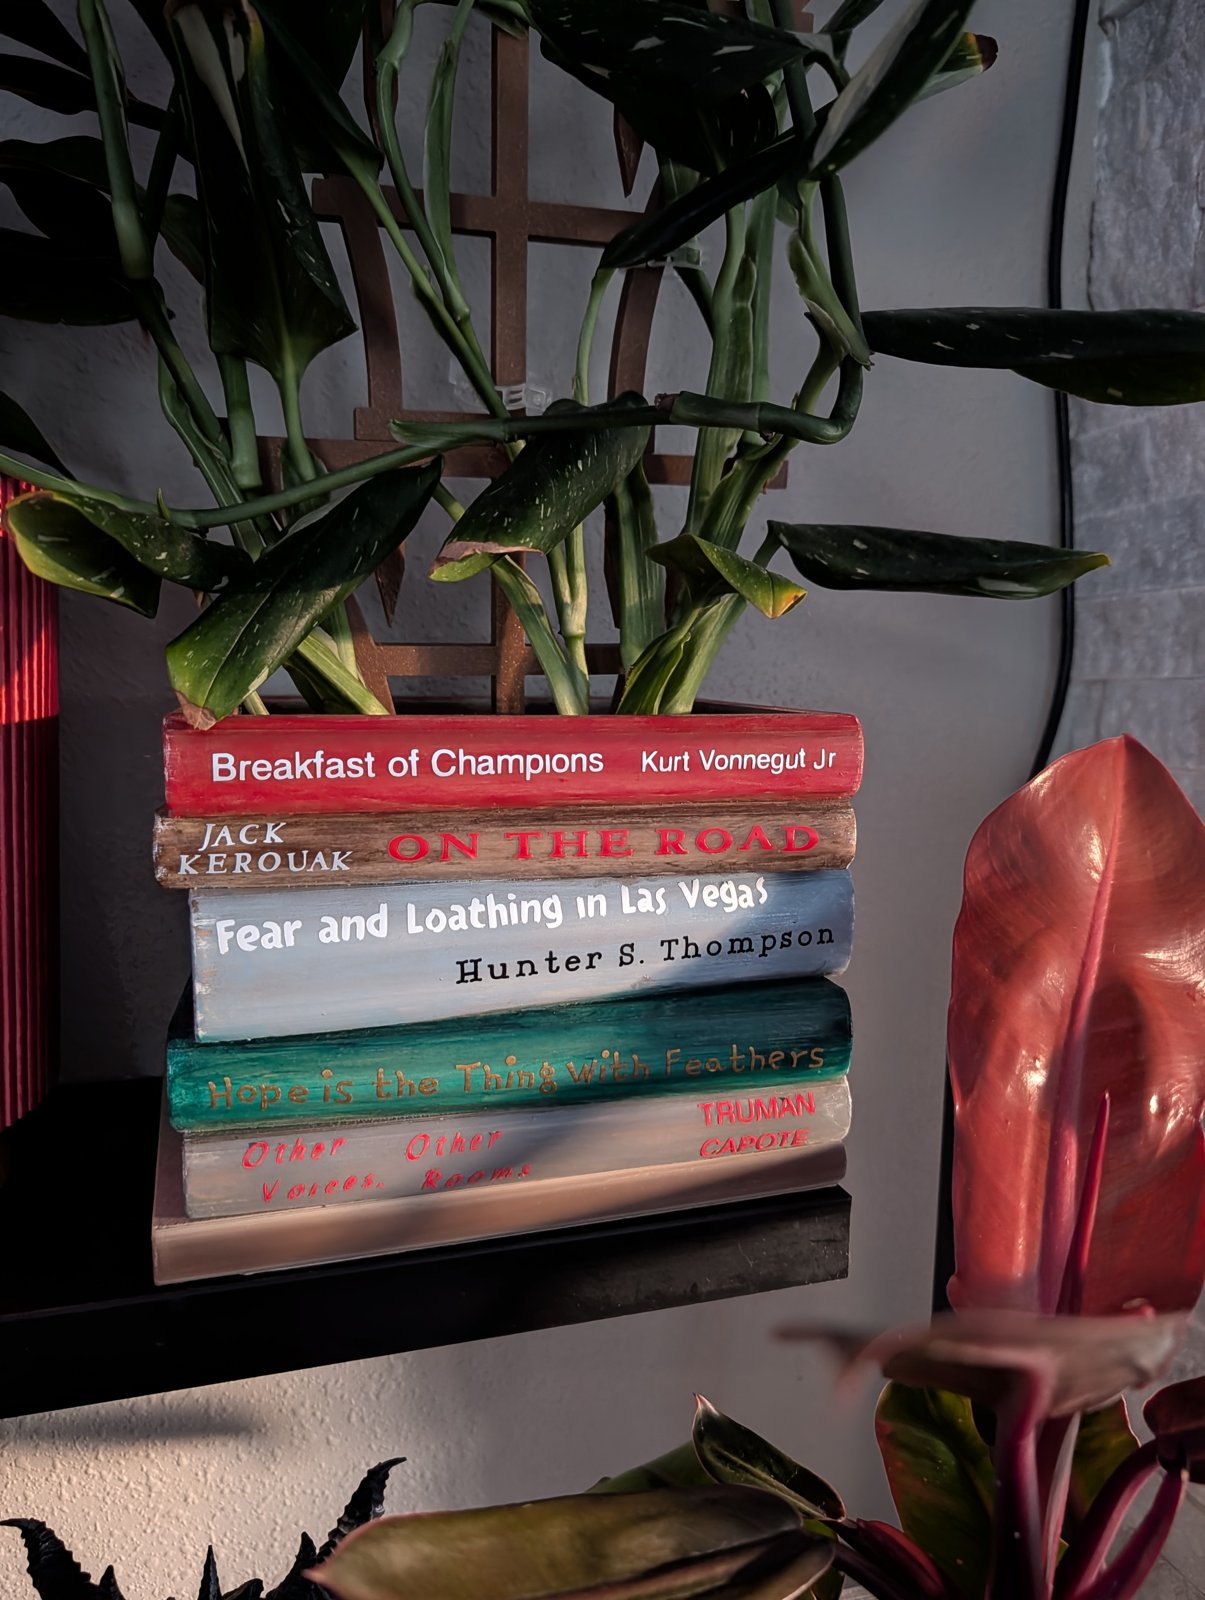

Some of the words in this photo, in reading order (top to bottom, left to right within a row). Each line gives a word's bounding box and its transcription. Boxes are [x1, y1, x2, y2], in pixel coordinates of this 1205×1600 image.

[212, 751, 376, 782] Breakfast
[387, 749, 419, 776] of
[431, 749, 604, 781] Champions
[641, 750, 690, 772] Kurt
[699, 748, 806, 774] Vonnegut
[813, 749, 837, 770] Jr
[199, 822, 286, 851] JACK
[387, 833, 480, 862] ON
[505, 829, 633, 860] THE
[655, 825, 820, 856] ROAD
[178, 851, 353, 875] KEROUAK
[216, 919, 302, 955] Fear
[319, 903, 388, 943] and
[407, 893, 563, 929] Loathing
[576, 895, 607, 919] in
[621, 885, 666, 915] Las
[678, 877, 768, 913] Vegas
[456, 950, 602, 984] Hunter
[619, 943, 645, 967] S.
[660, 927, 835, 962] Thompson
[208, 1076, 308, 1111] Hope
[320, 1069, 353, 1105] is
[372, 1067, 439, 1100] the
[455, 1055, 557, 1094] Thing
[665, 1044, 824, 1077] Feathers
[697, 1092, 815, 1128] TRUMAN
[241, 1136, 346, 1169] Other
[405, 1130, 503, 1162] Other
[699, 1129, 811, 1159] CAPOTE
[421, 1164, 532, 1191] Rooms
